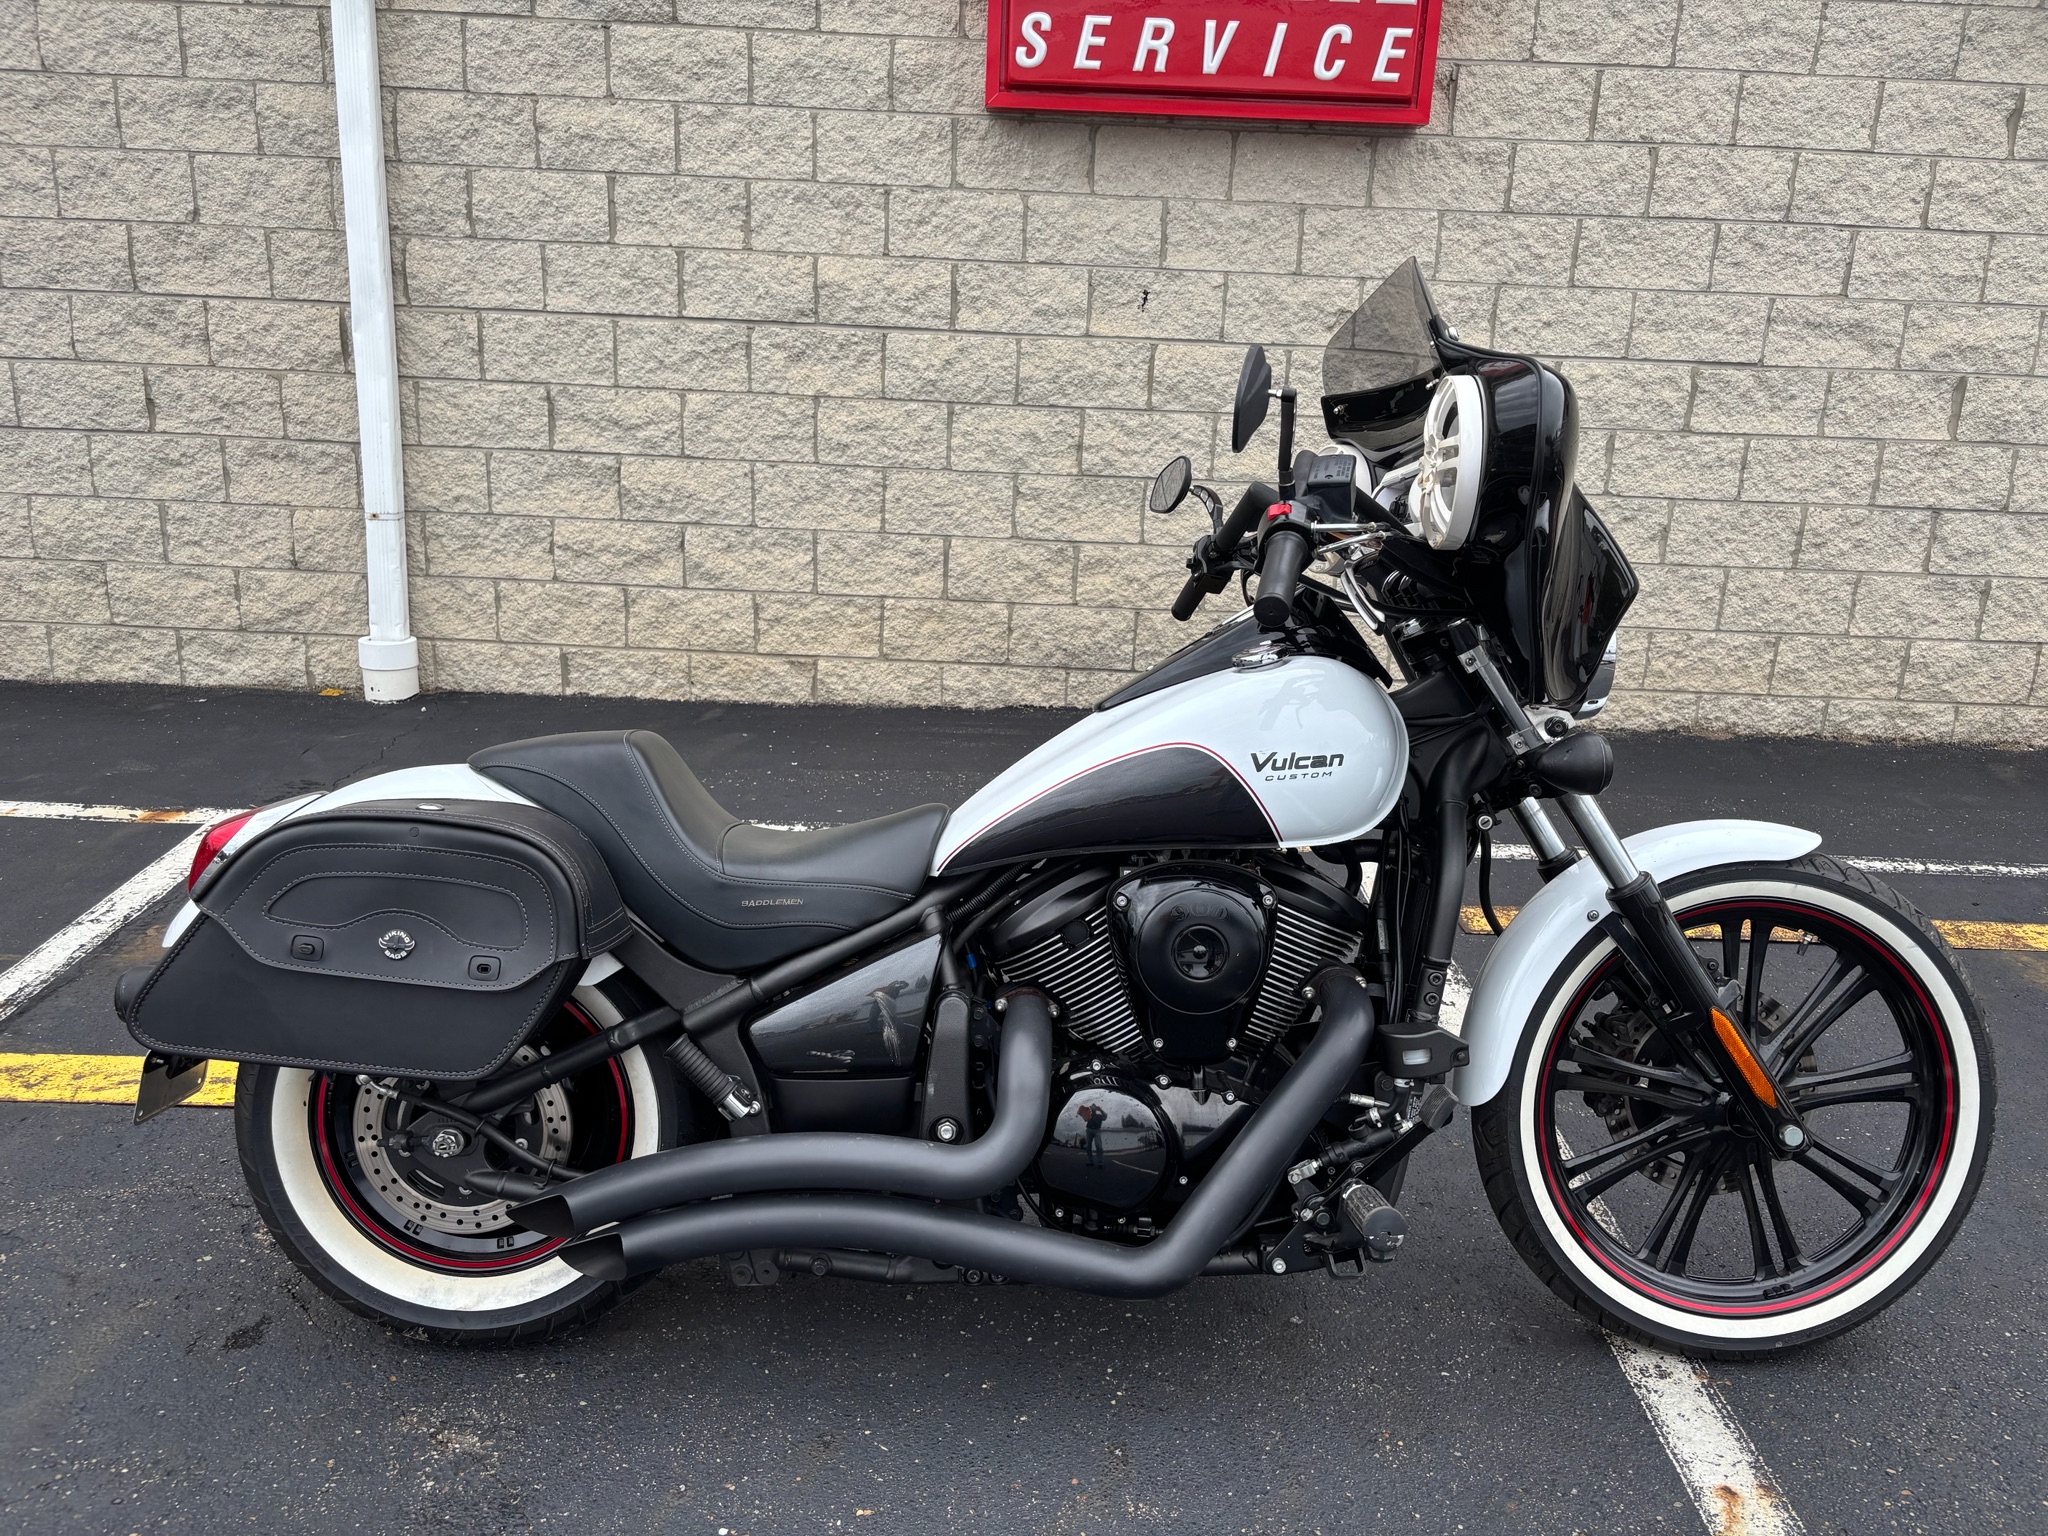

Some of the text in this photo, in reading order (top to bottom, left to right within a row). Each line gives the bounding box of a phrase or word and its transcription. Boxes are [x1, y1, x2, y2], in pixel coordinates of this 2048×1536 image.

[1014, 11, 1414, 83] SERVICE
[1250, 752, 1344, 772] Vulcan
[1265, 771, 1333, 781] CUSTOM
[741, 898, 804, 907] SADDLEMEN
[383, 930, 411, 943] VIKING
